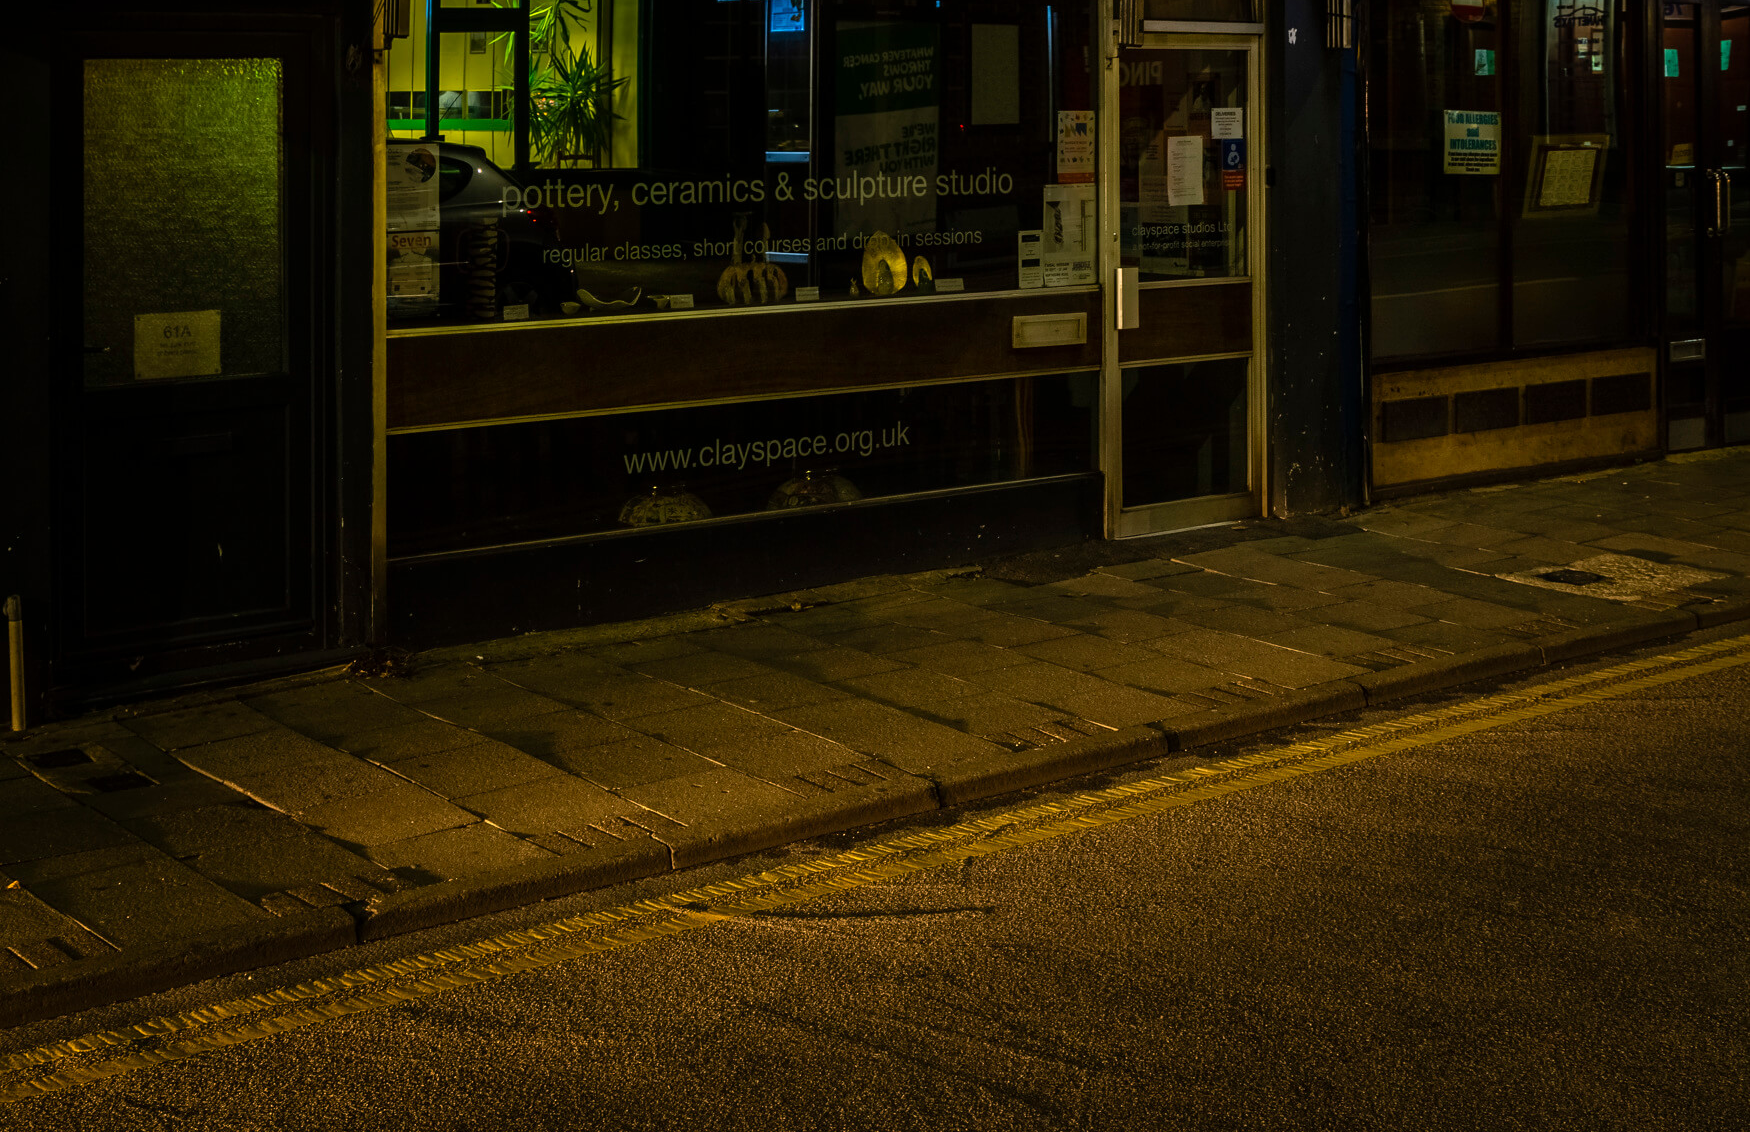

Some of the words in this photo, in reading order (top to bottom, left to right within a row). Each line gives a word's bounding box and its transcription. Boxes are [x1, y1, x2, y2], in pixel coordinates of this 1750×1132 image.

[1450, 138, 1497, 150] INTOLERANCES
[502, 178, 619, 216] pottery,
[631, 172, 765, 207] ceramics
[774, 171, 795, 202] &
[803, 169, 927, 206] sculpture
[936, 166, 1013, 197] studio
[1132, 223, 1179, 238] clayspace
[1181, 220, 1216, 234] studios
[391, 234, 432, 248] Seven
[543, 242, 608, 268] regular
[614, 240, 687, 261] classes,
[744, 237, 811, 255] courses
[816, 232, 847, 252] and
[915, 227, 982, 247] sessions
[163, 324, 192, 339] 61A
[623, 420, 910, 475] www.clayspace.org.uk
